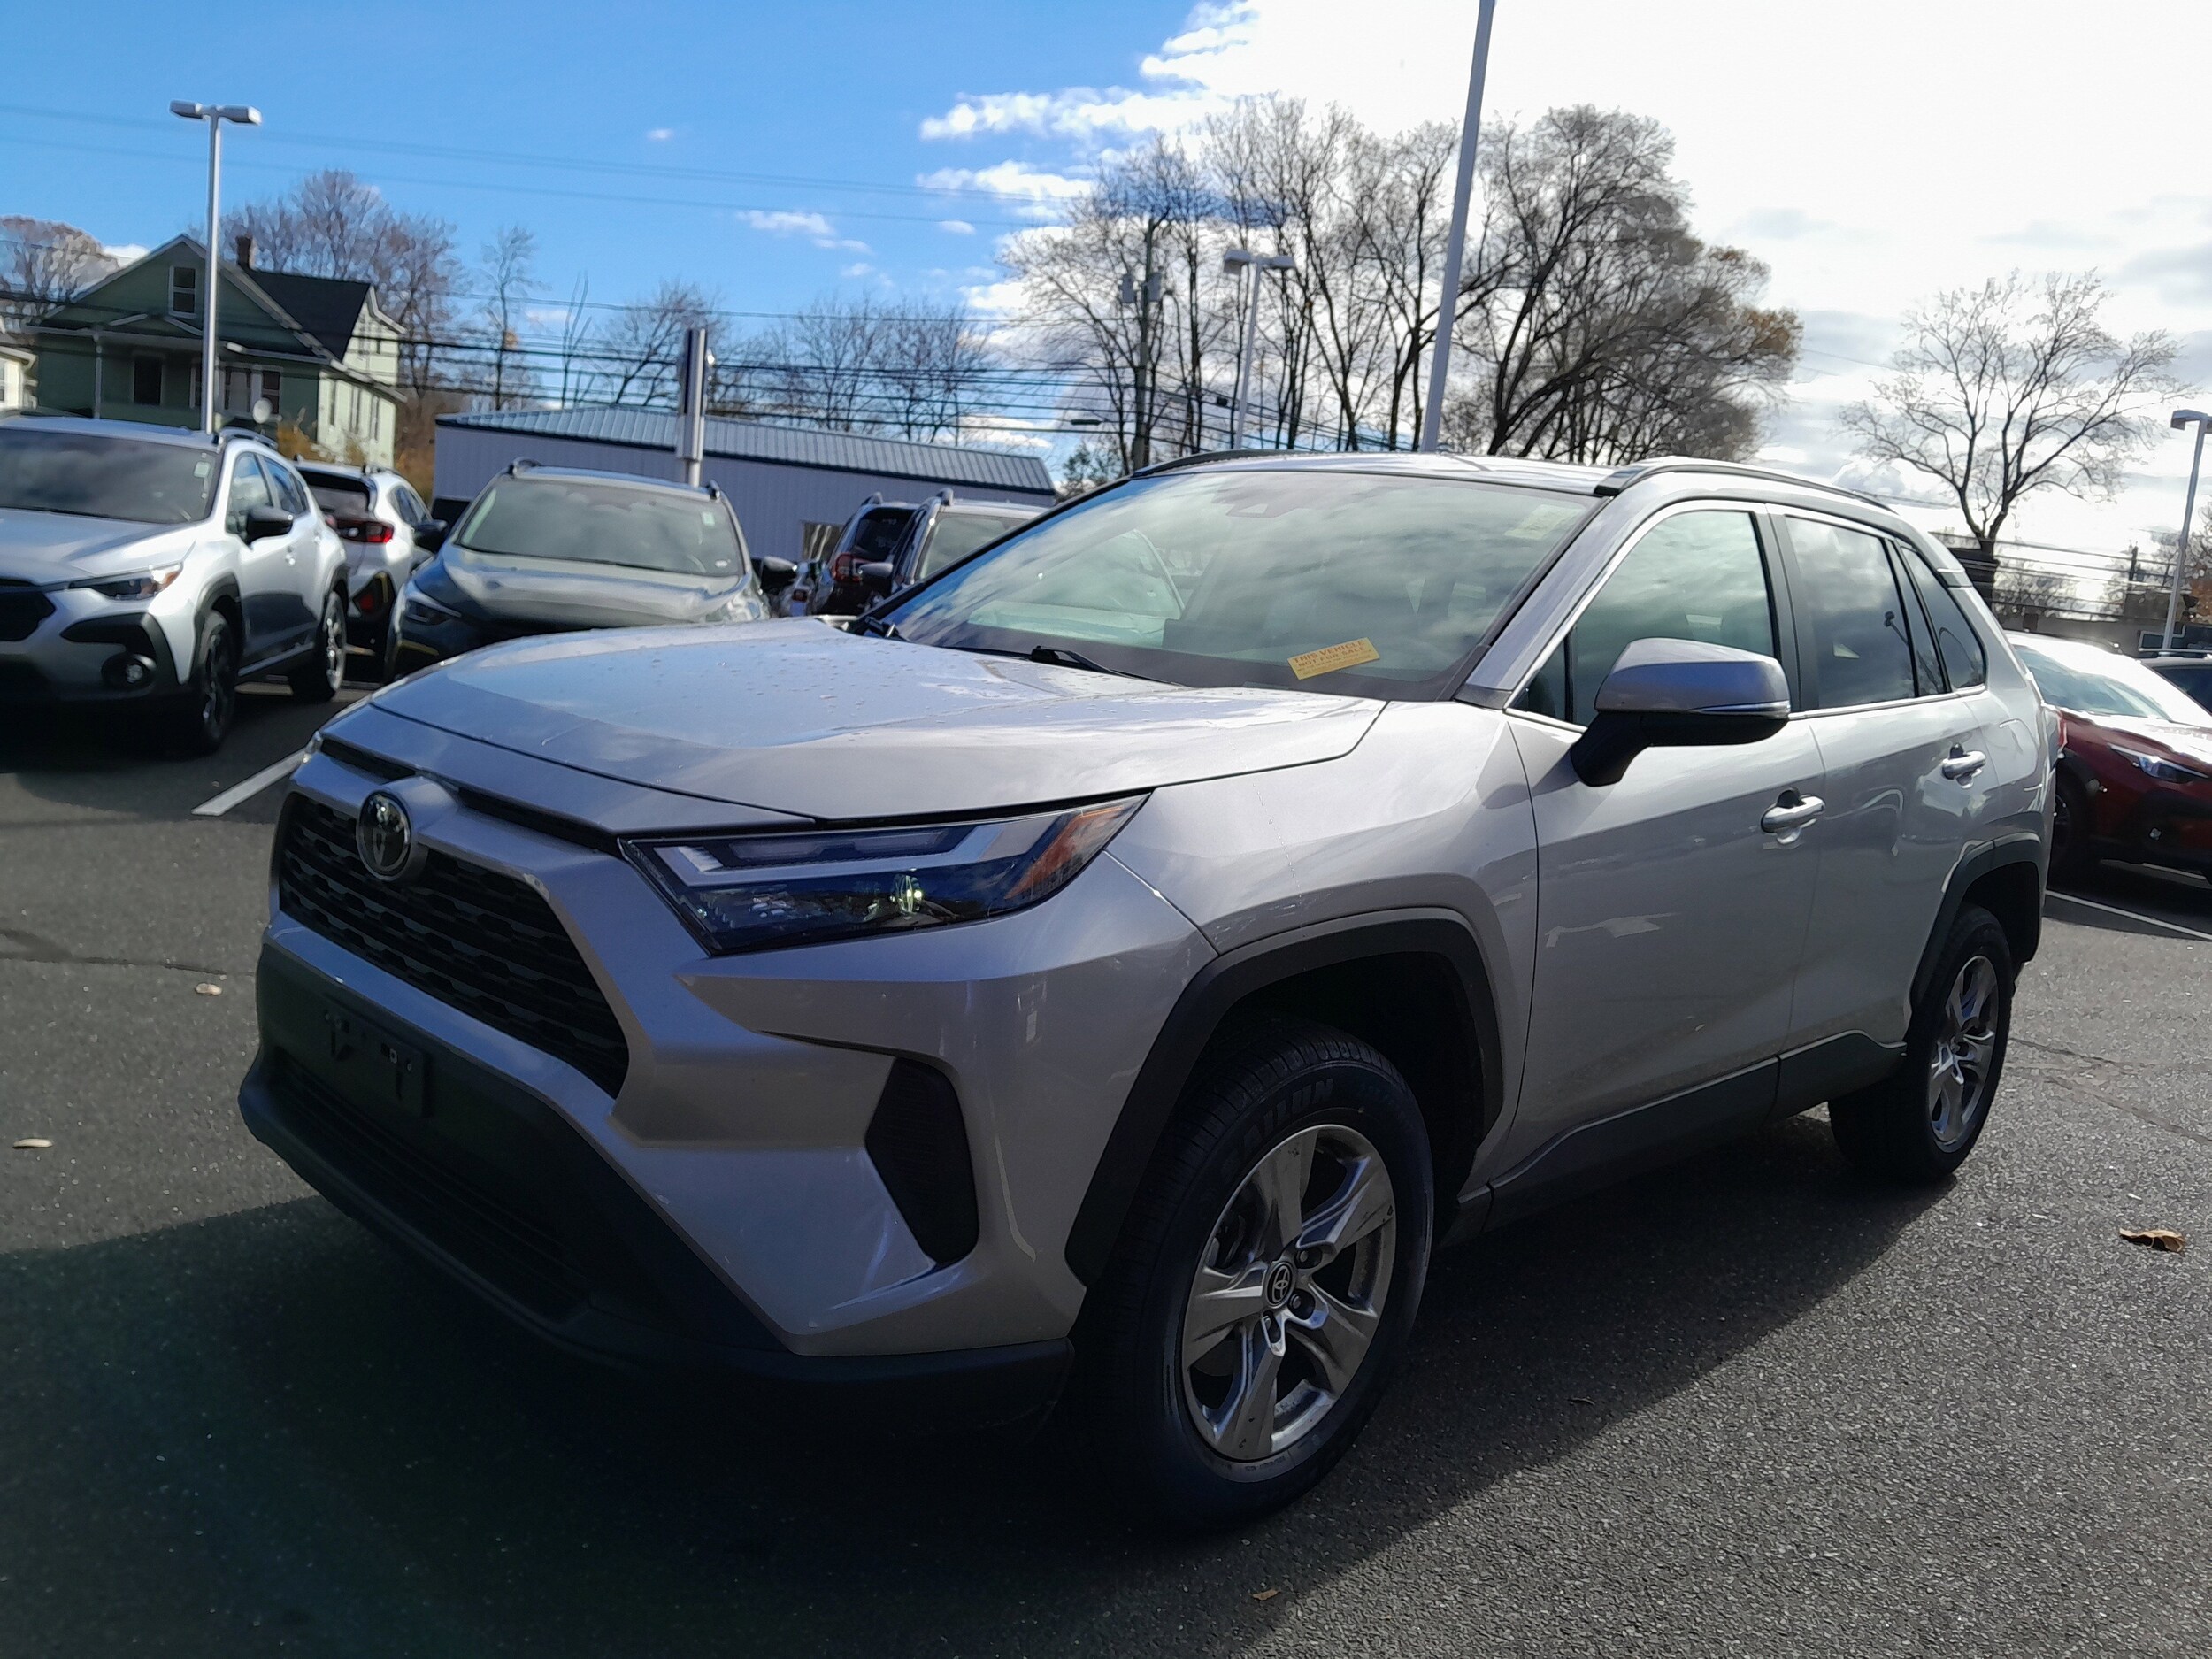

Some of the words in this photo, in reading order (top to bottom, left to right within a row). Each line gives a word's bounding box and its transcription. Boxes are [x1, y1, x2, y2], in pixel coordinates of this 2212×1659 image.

[1294, 653, 1318, 664] THIS
[1319, 641, 1364, 656] VEHICLE
[1298, 657, 1317, 667] NOT
[1319, 653, 1340, 662] FOR
[1342, 646, 1364, 656] SALE
[1220, 1078, 1334, 1175] SAILUN
